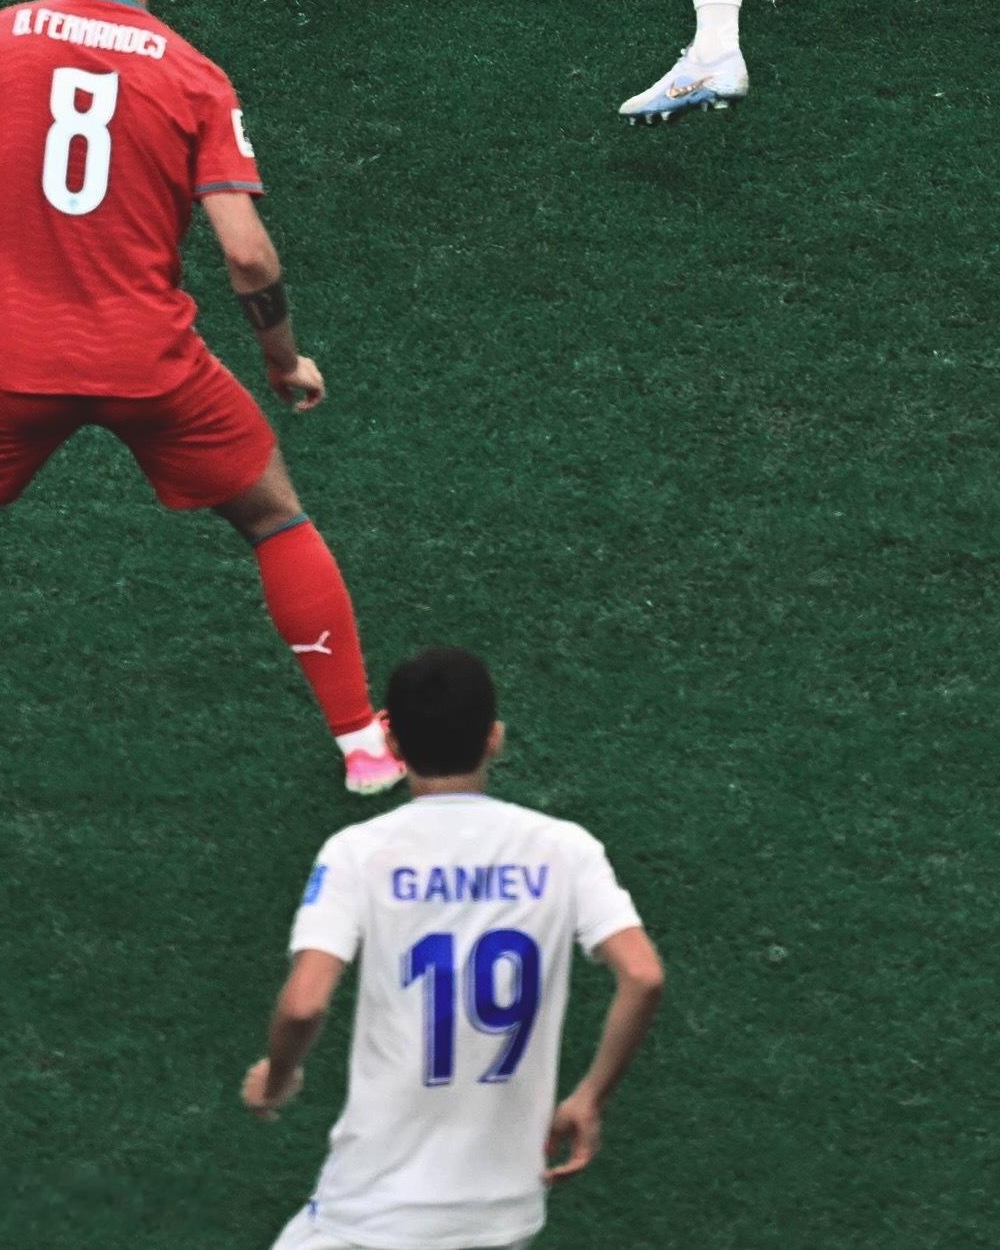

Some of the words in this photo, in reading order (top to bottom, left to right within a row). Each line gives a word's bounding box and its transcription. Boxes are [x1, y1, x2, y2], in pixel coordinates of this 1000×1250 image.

[42, 66, 120, 216] 8
[391, 863, 548, 903] GANIEV
[399, 926, 543, 1088] 19
